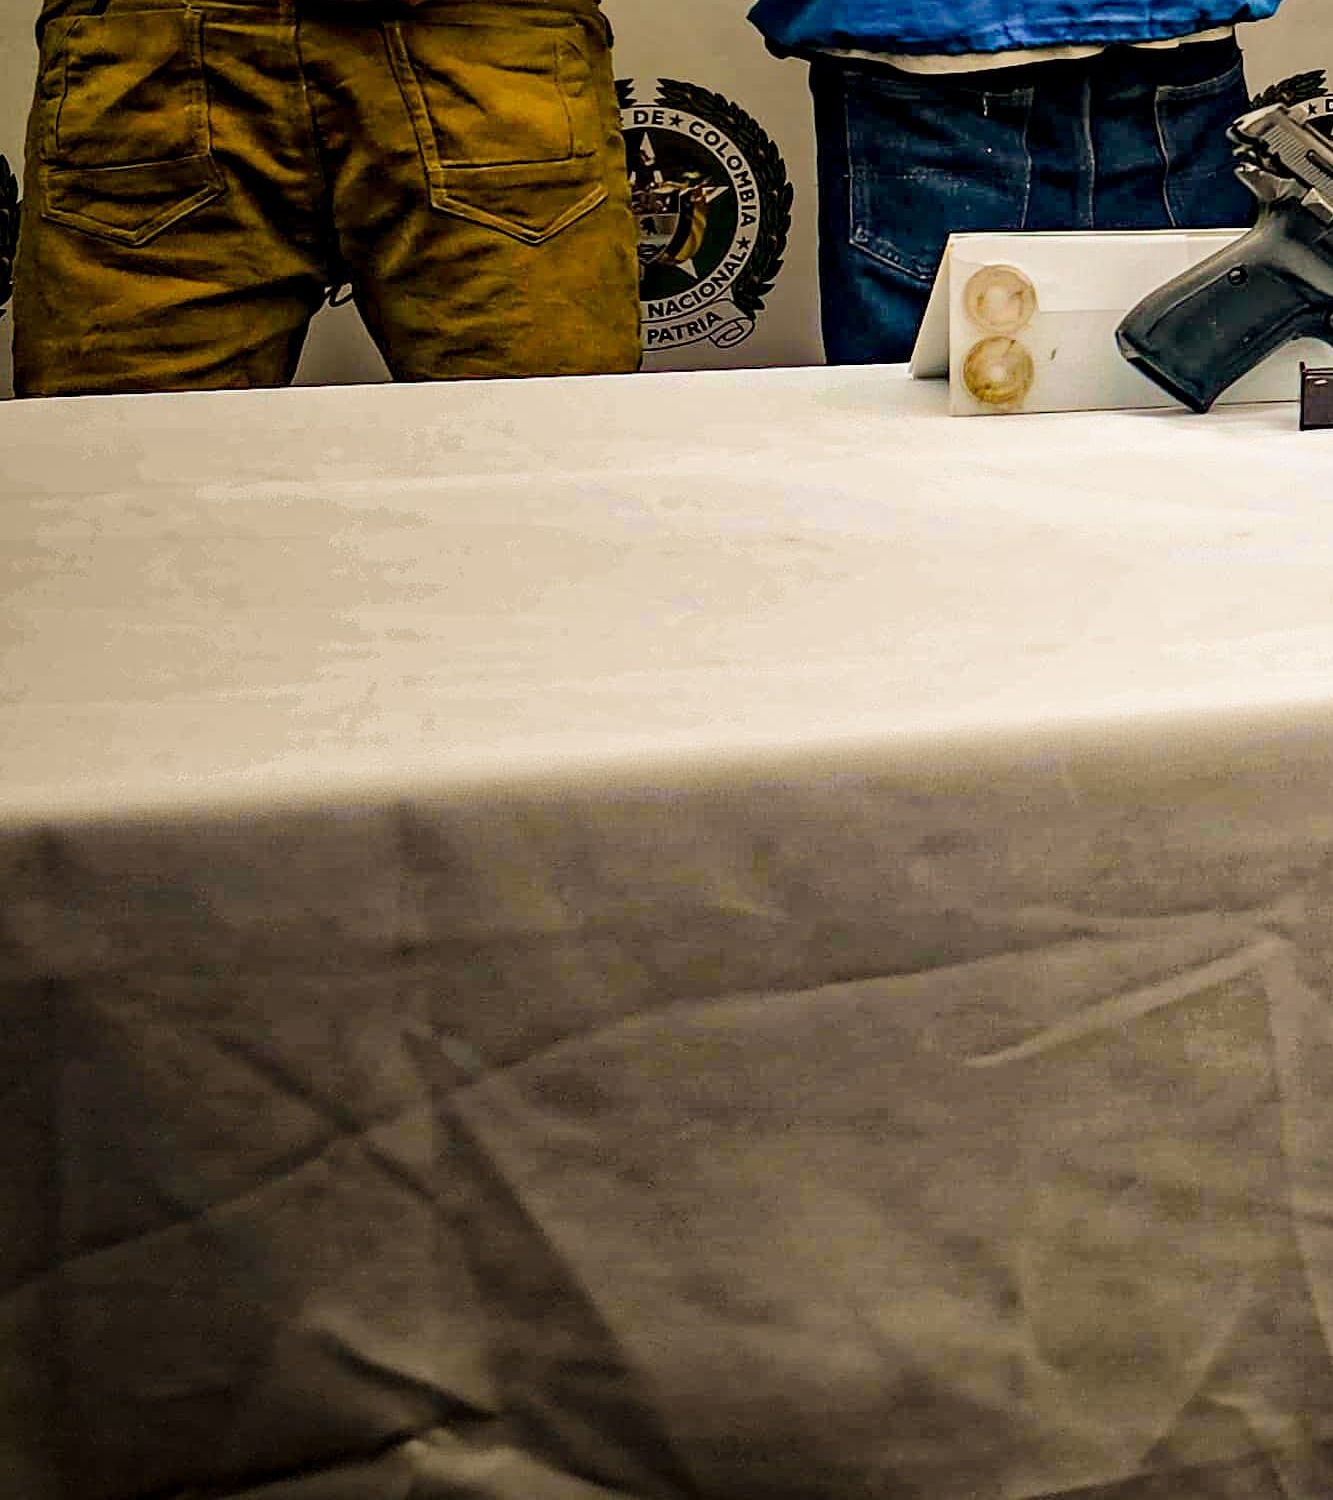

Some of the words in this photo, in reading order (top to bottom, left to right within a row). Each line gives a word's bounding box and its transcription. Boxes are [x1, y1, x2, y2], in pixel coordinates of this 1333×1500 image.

[633, 111, 665, 126] DE
[688, 121, 756, 227] COLOMBIA
[648, 252, 747, 318] NACIONAL
[647, 312, 722, 343] PATRIA
